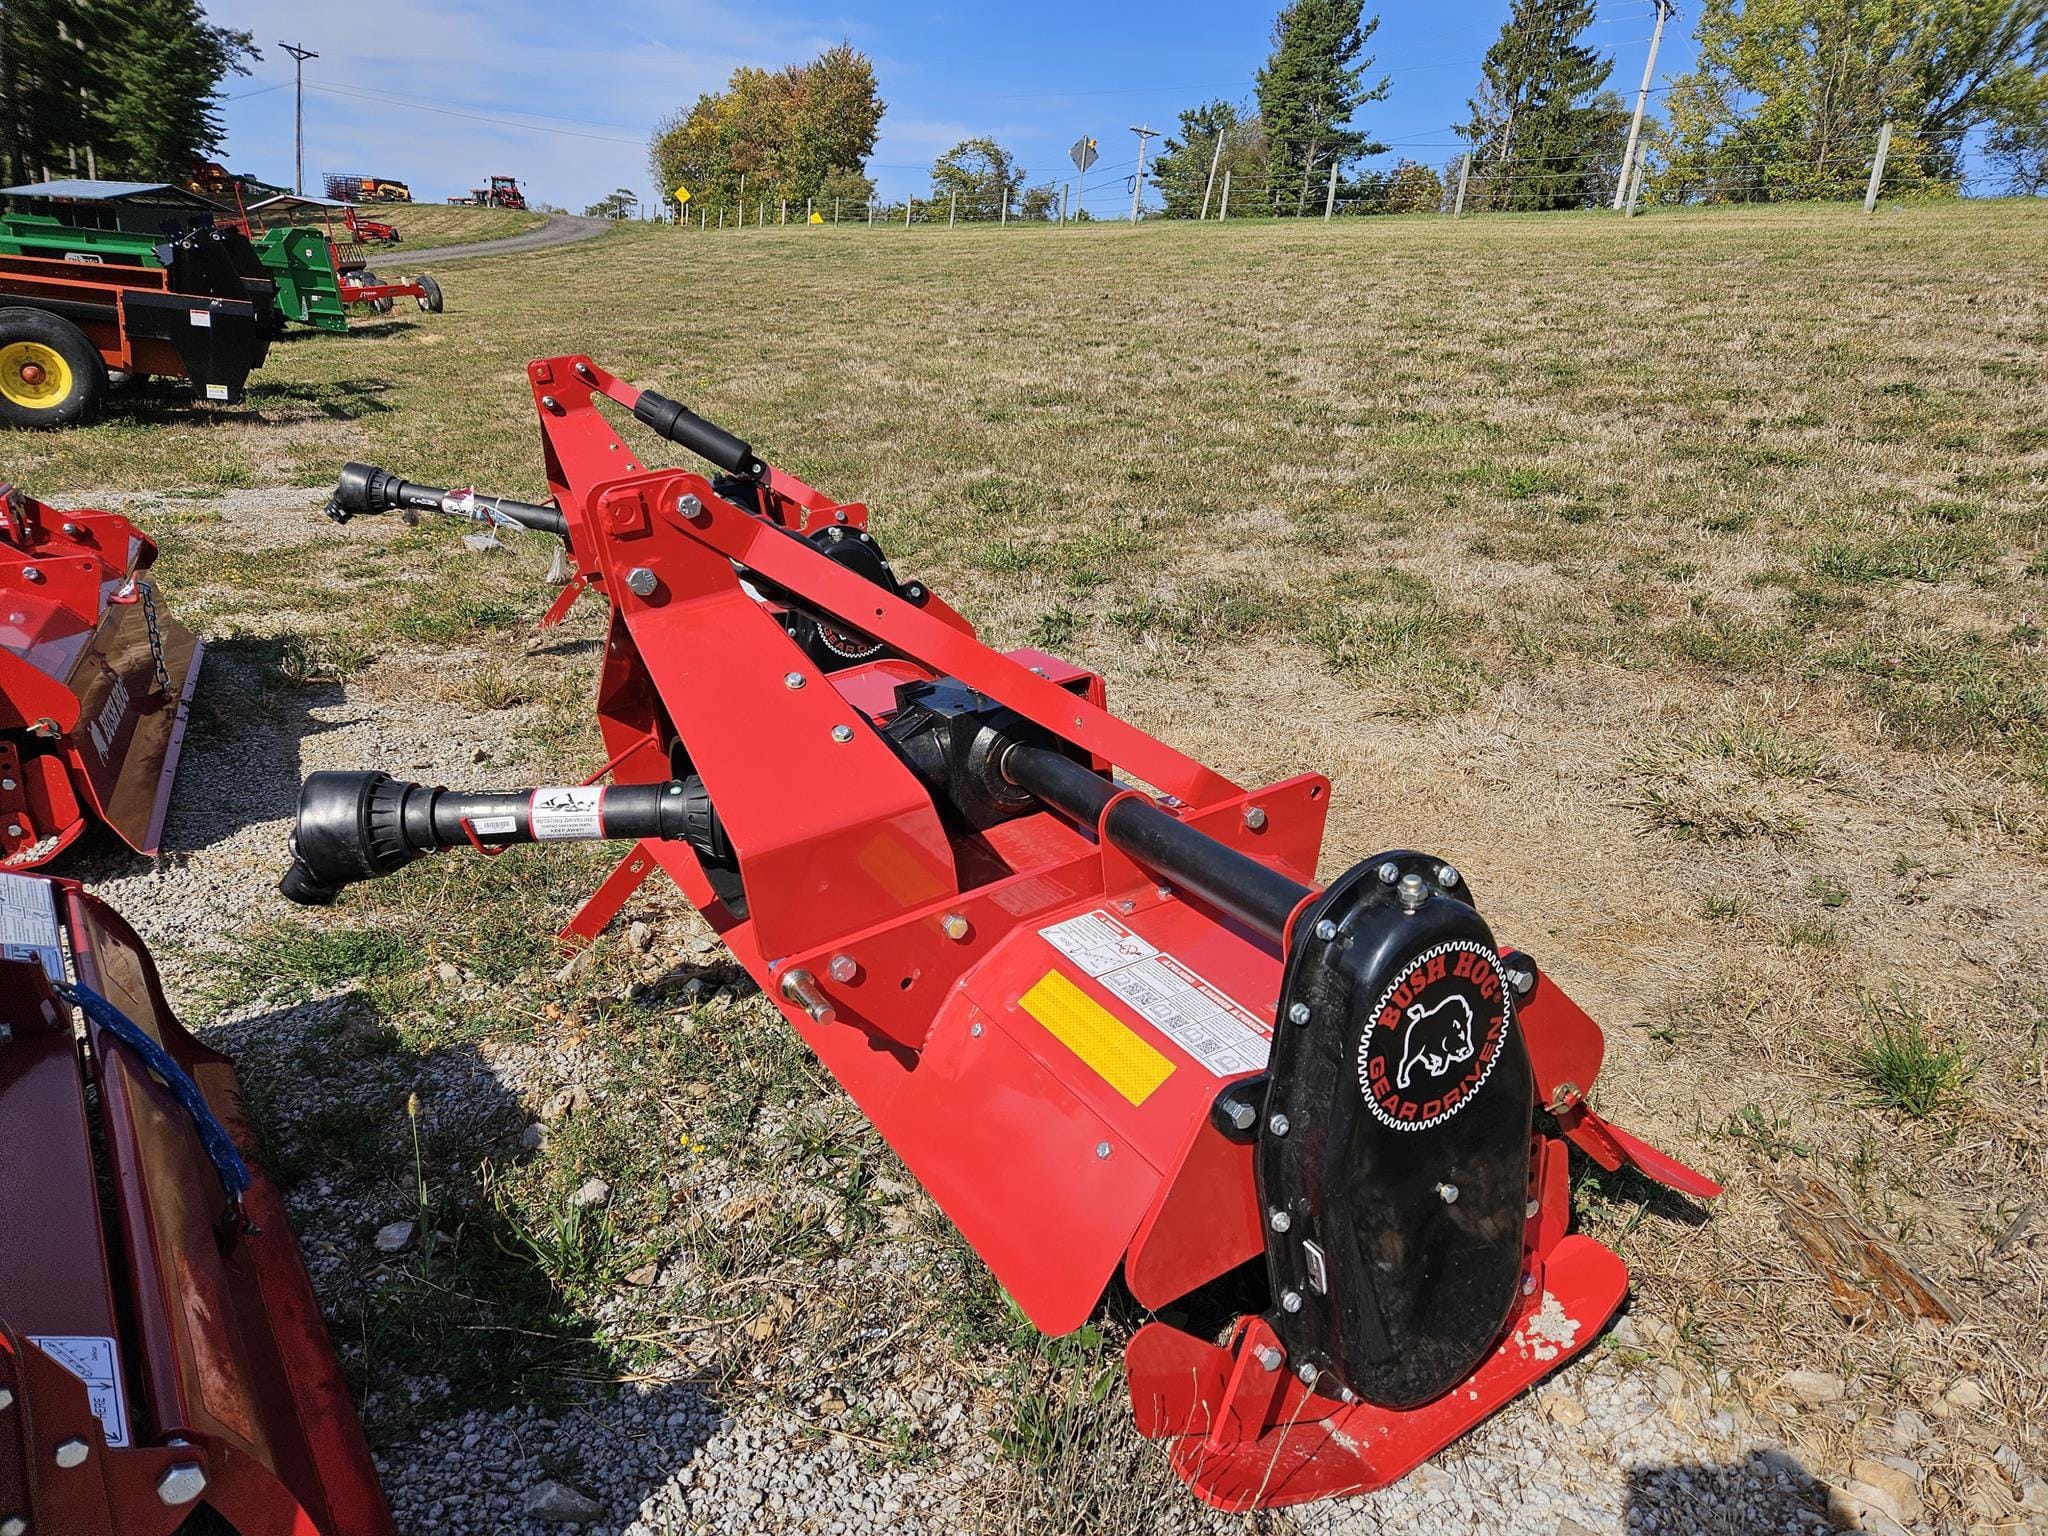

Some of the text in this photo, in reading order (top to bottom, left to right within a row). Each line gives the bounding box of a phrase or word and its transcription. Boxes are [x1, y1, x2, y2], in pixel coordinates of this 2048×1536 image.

[1168, 960, 1196, 984] PELIGRO
[1203, 986, 1233, 1011] DANGER
[1237, 1010, 1266, 1034] PERIGO
[1378, 954, 1447, 1032] BUSH
[1369, 1015, 1503, 1121] GEAR DRIVEN
